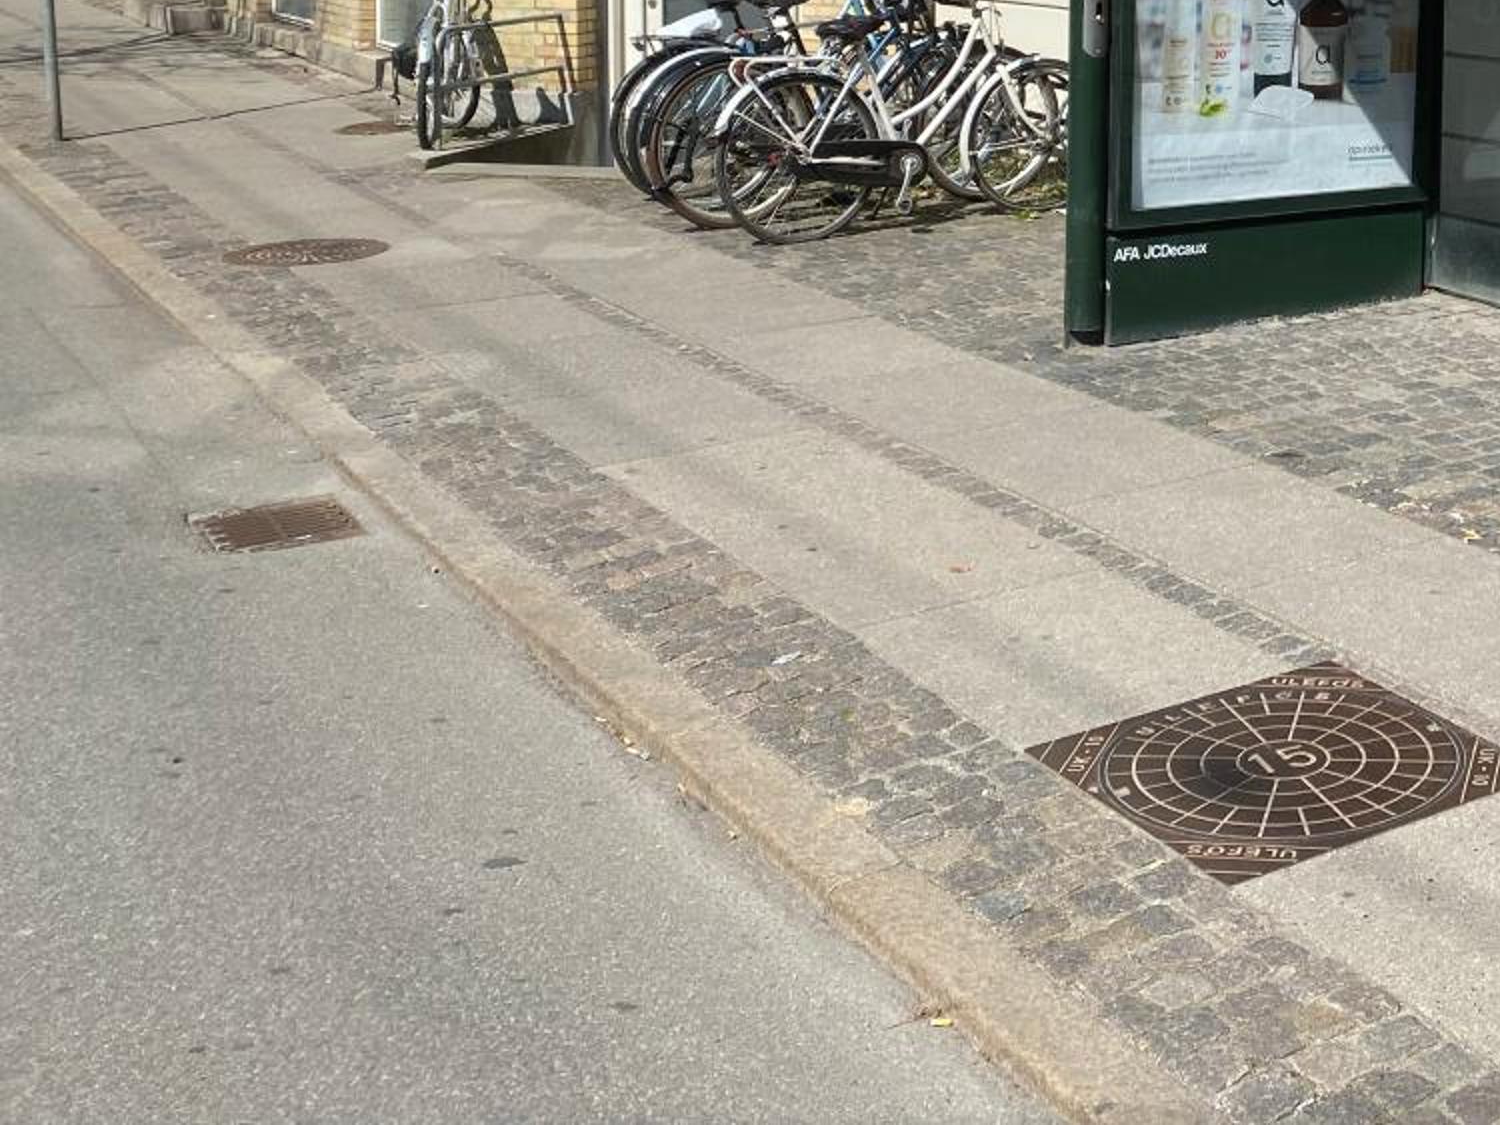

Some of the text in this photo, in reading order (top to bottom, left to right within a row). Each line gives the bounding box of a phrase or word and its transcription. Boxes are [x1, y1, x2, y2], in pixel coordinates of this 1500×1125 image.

[1113, 243, 1208, 262] AFA JCDecaux
[1247, 744, 1318, 774] 15
